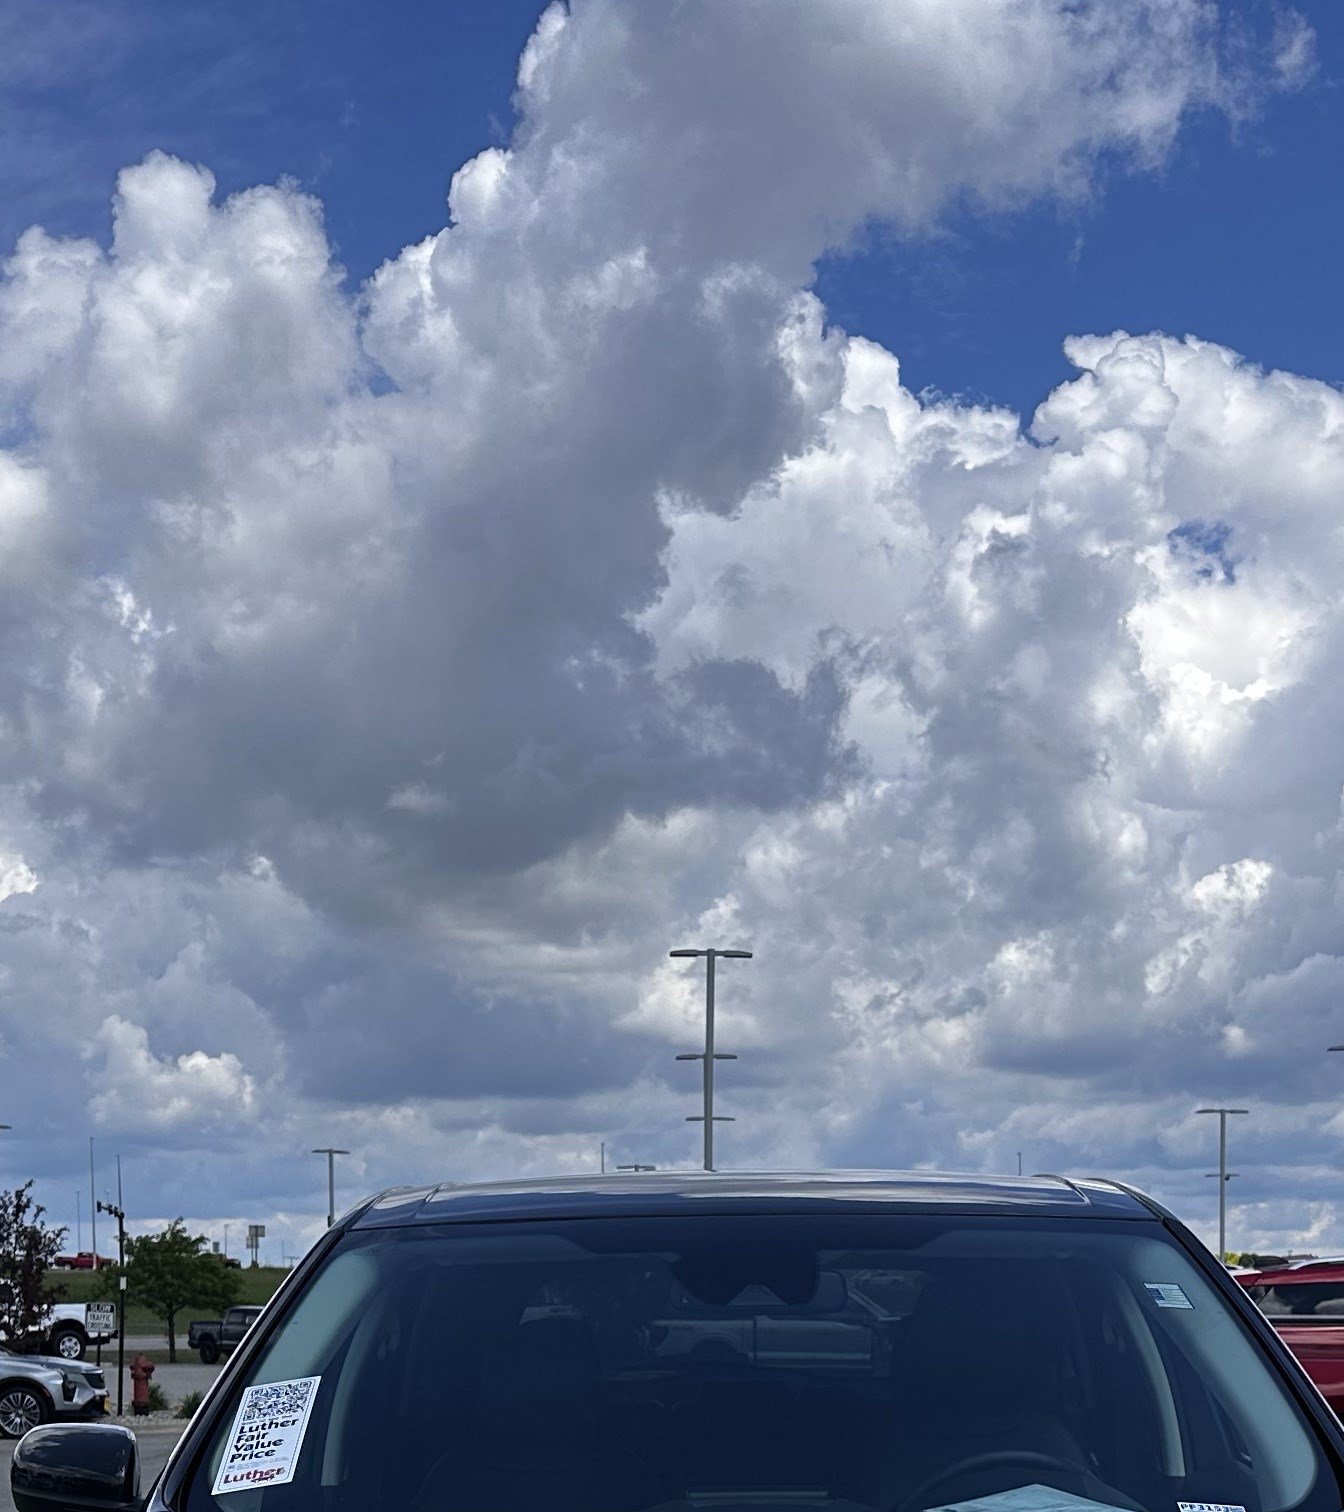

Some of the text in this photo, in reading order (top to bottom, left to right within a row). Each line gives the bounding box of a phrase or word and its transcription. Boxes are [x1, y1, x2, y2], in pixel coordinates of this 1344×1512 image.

[239, 1419, 299, 1434] Luther
[236, 1431, 269, 1444] Fair
[234, 1439, 284, 1452] Value
[230, 1449, 276, 1463] Price
[224, 1467, 285, 1484] Luther
